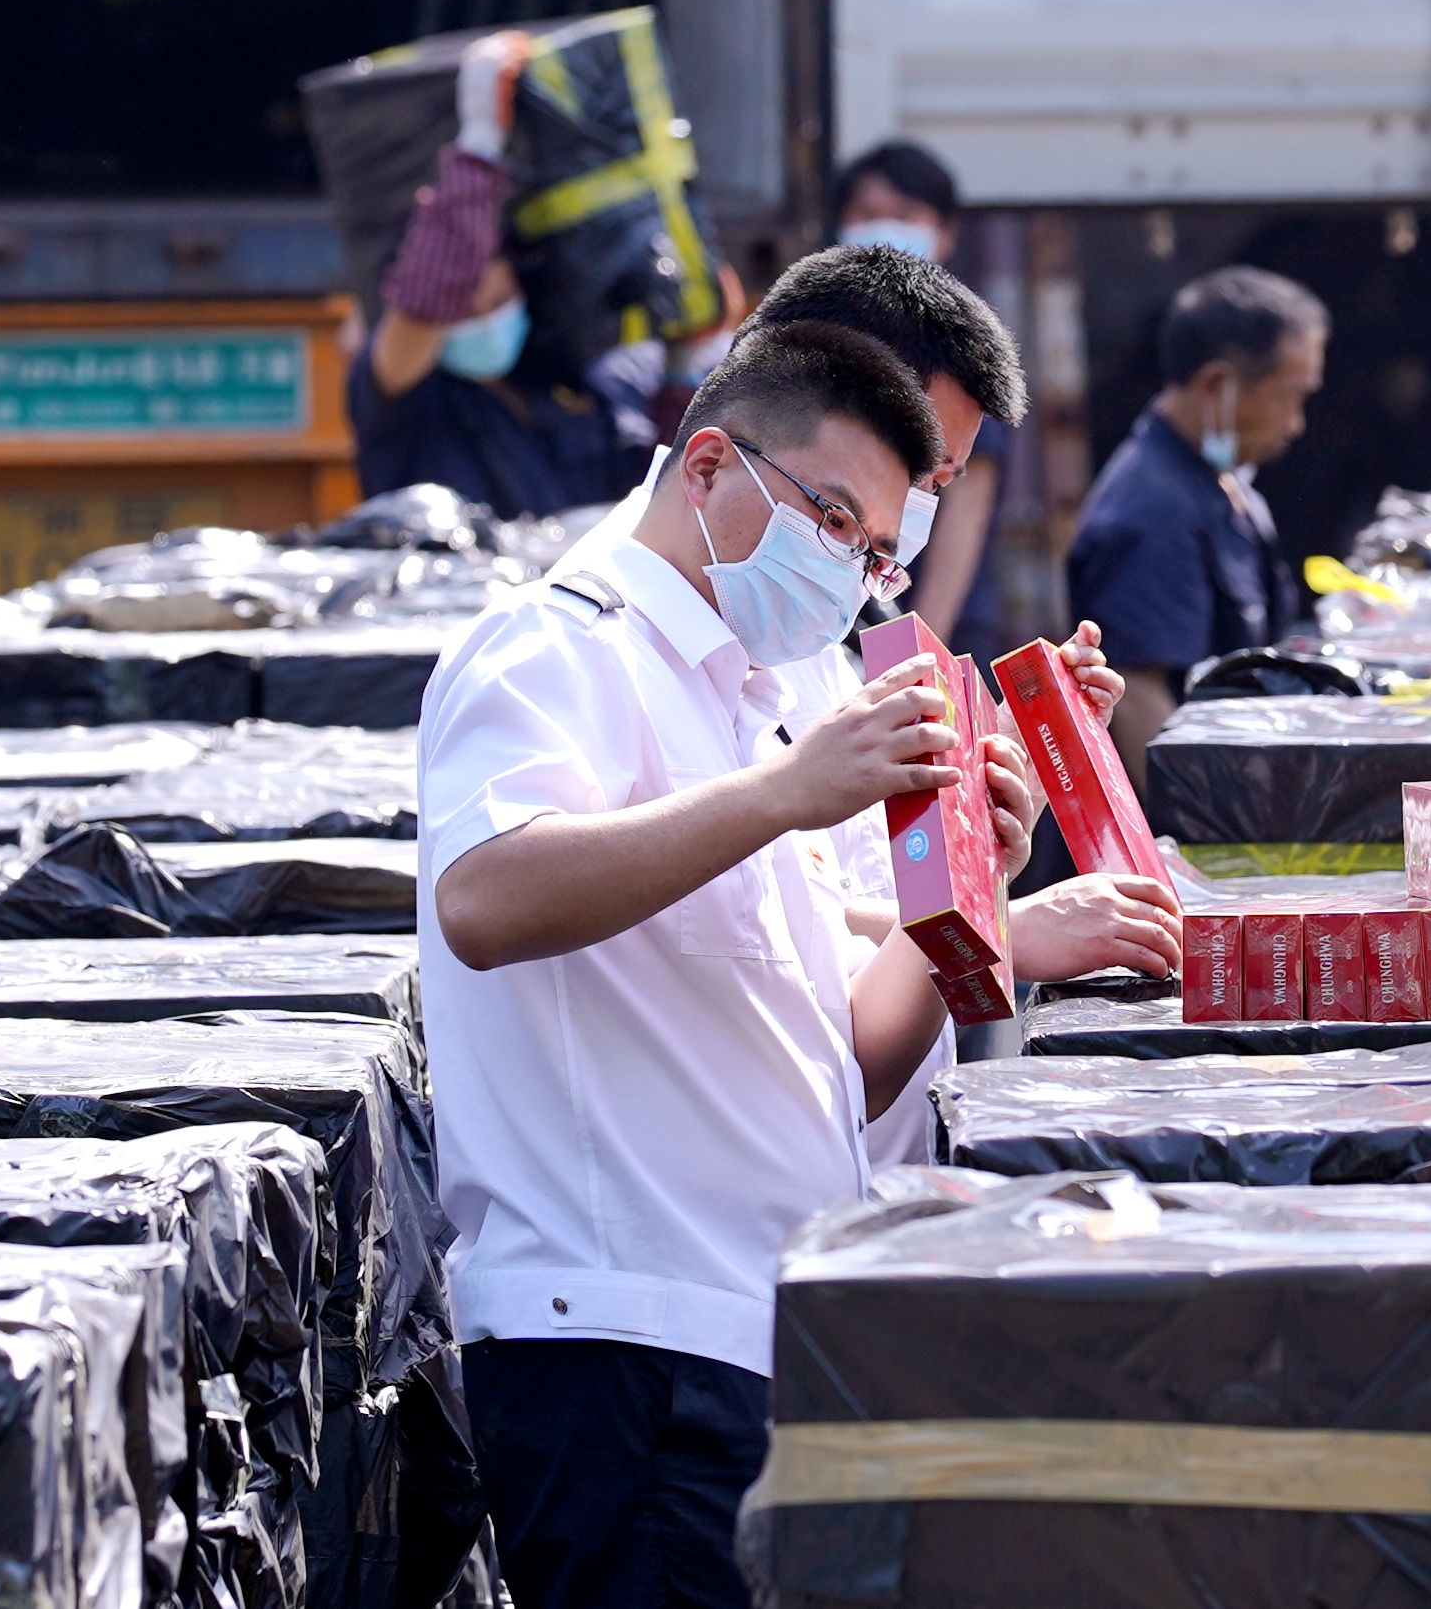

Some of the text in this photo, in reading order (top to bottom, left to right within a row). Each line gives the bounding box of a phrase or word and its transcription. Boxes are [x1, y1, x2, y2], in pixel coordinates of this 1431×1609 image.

[1038, 722, 1074, 793] CIGARETTES
[1211, 934, 1226, 1006] CHUNGHWA
[1272, 934, 1287, 1006] CHUNGHWA
[1319, 934, 1335, 1006] CHUNGHWA
[1378, 932, 1395, 1004] CHUNGHWA
